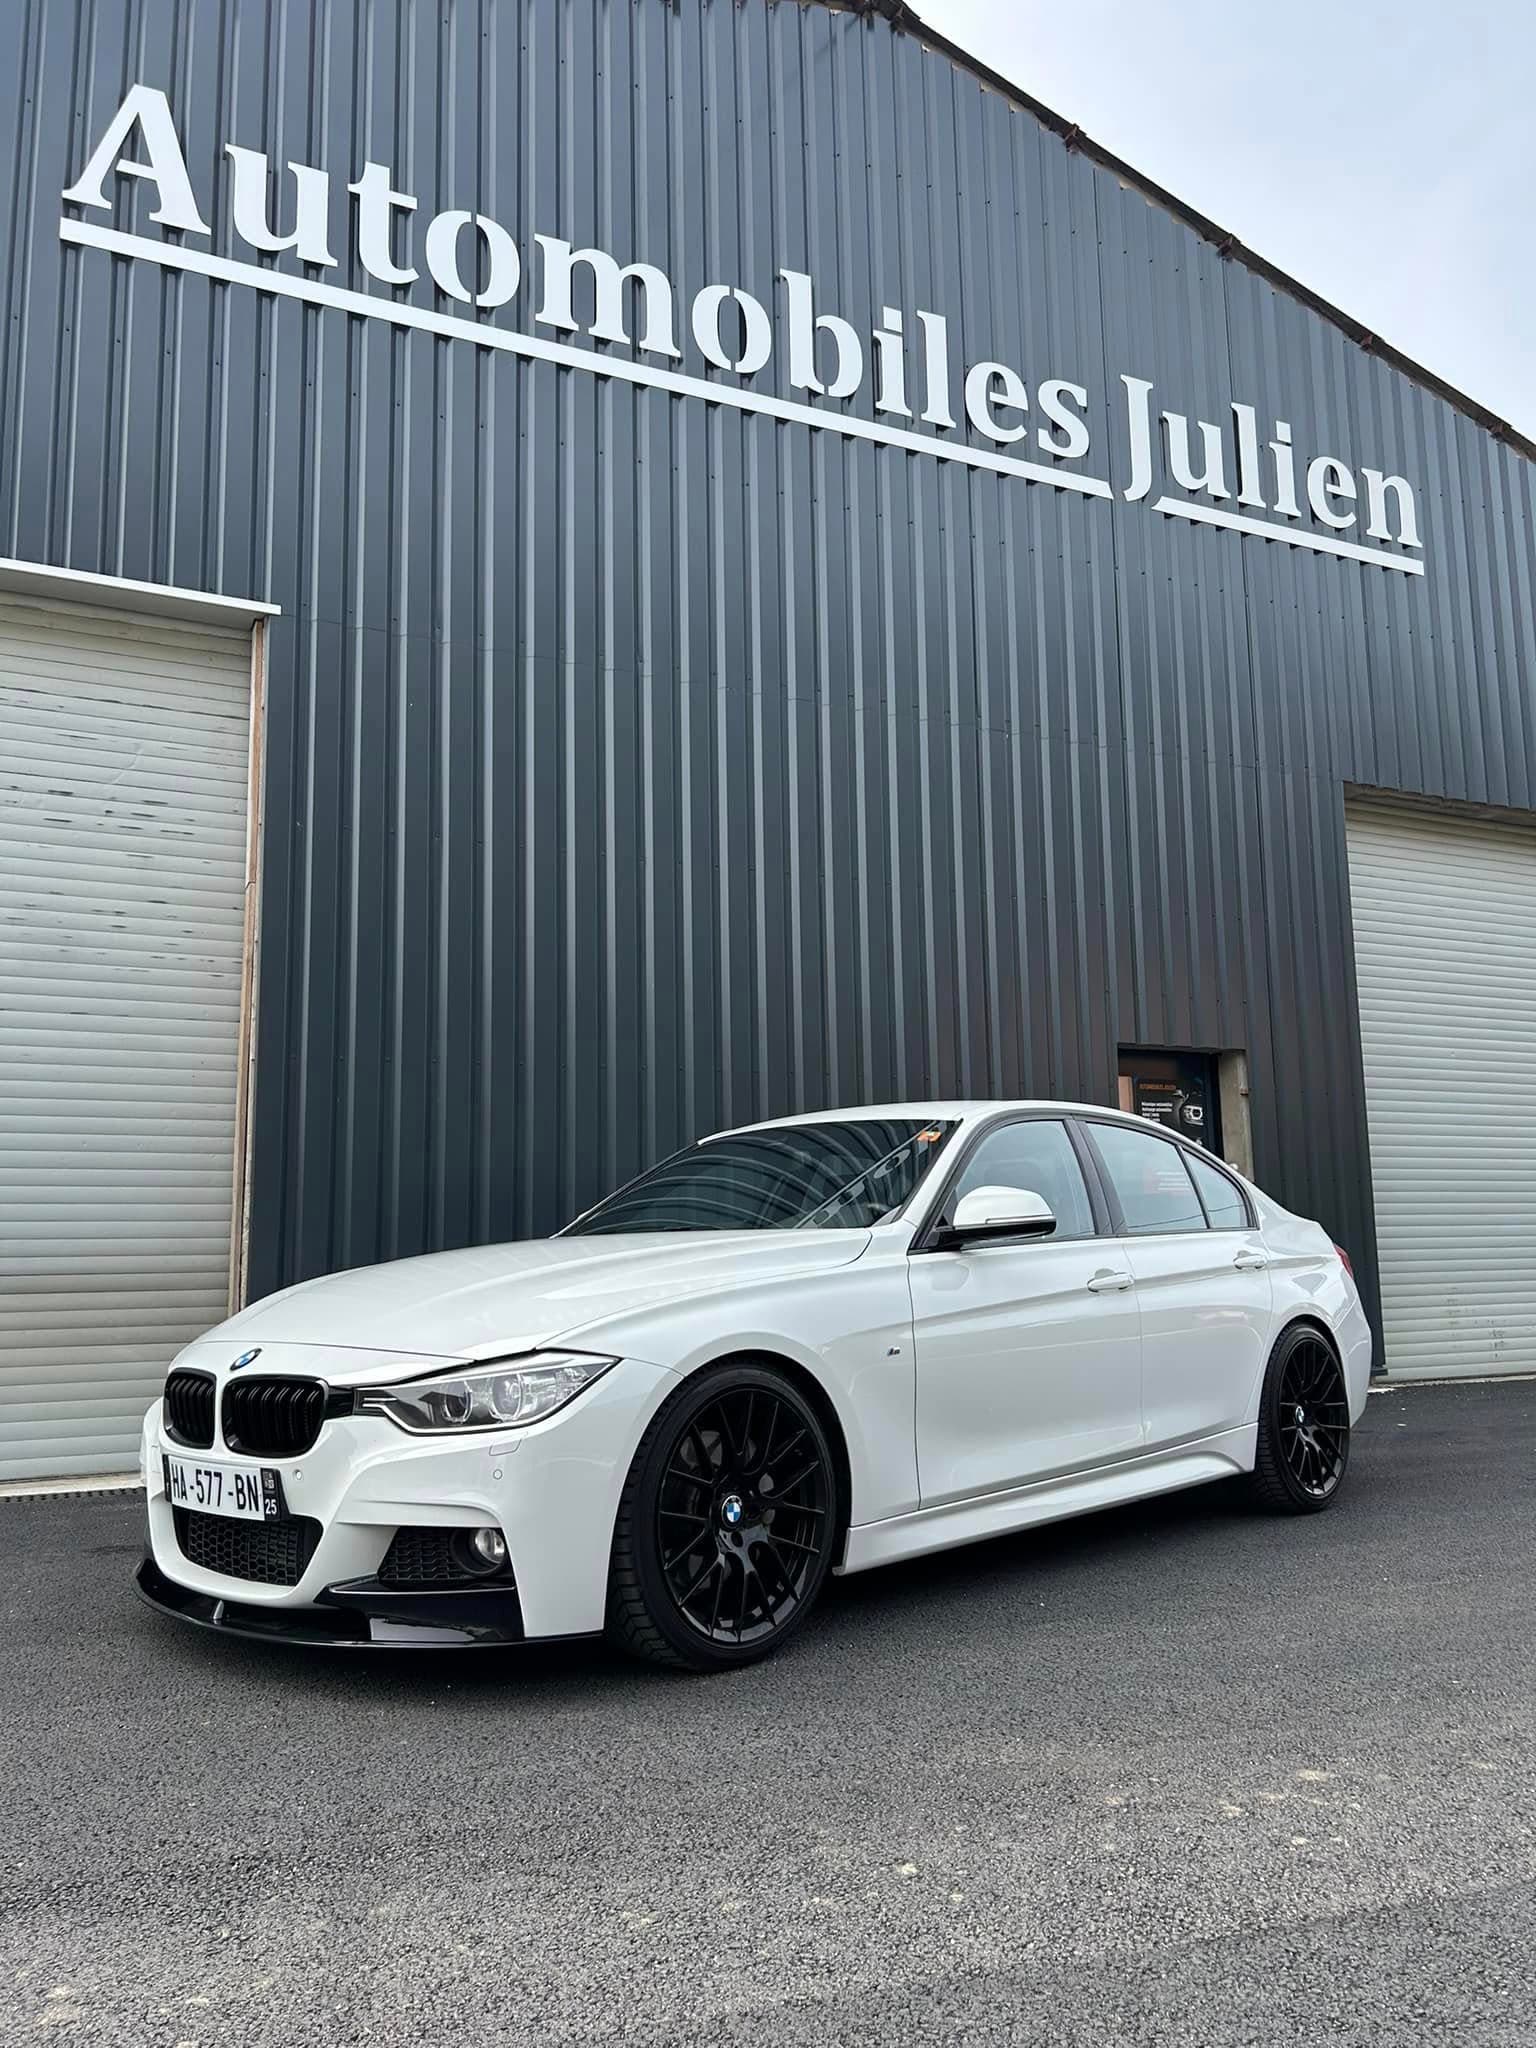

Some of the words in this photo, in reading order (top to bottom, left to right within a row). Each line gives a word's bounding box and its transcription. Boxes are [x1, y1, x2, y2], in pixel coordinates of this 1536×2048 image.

[62, 83, 1089, 459] Automobiles
[1119, 374, 1424, 548] Julien
[171, 1463, 259, 1512] HA-577-BN
[265, 1498, 277, 1515] 25
